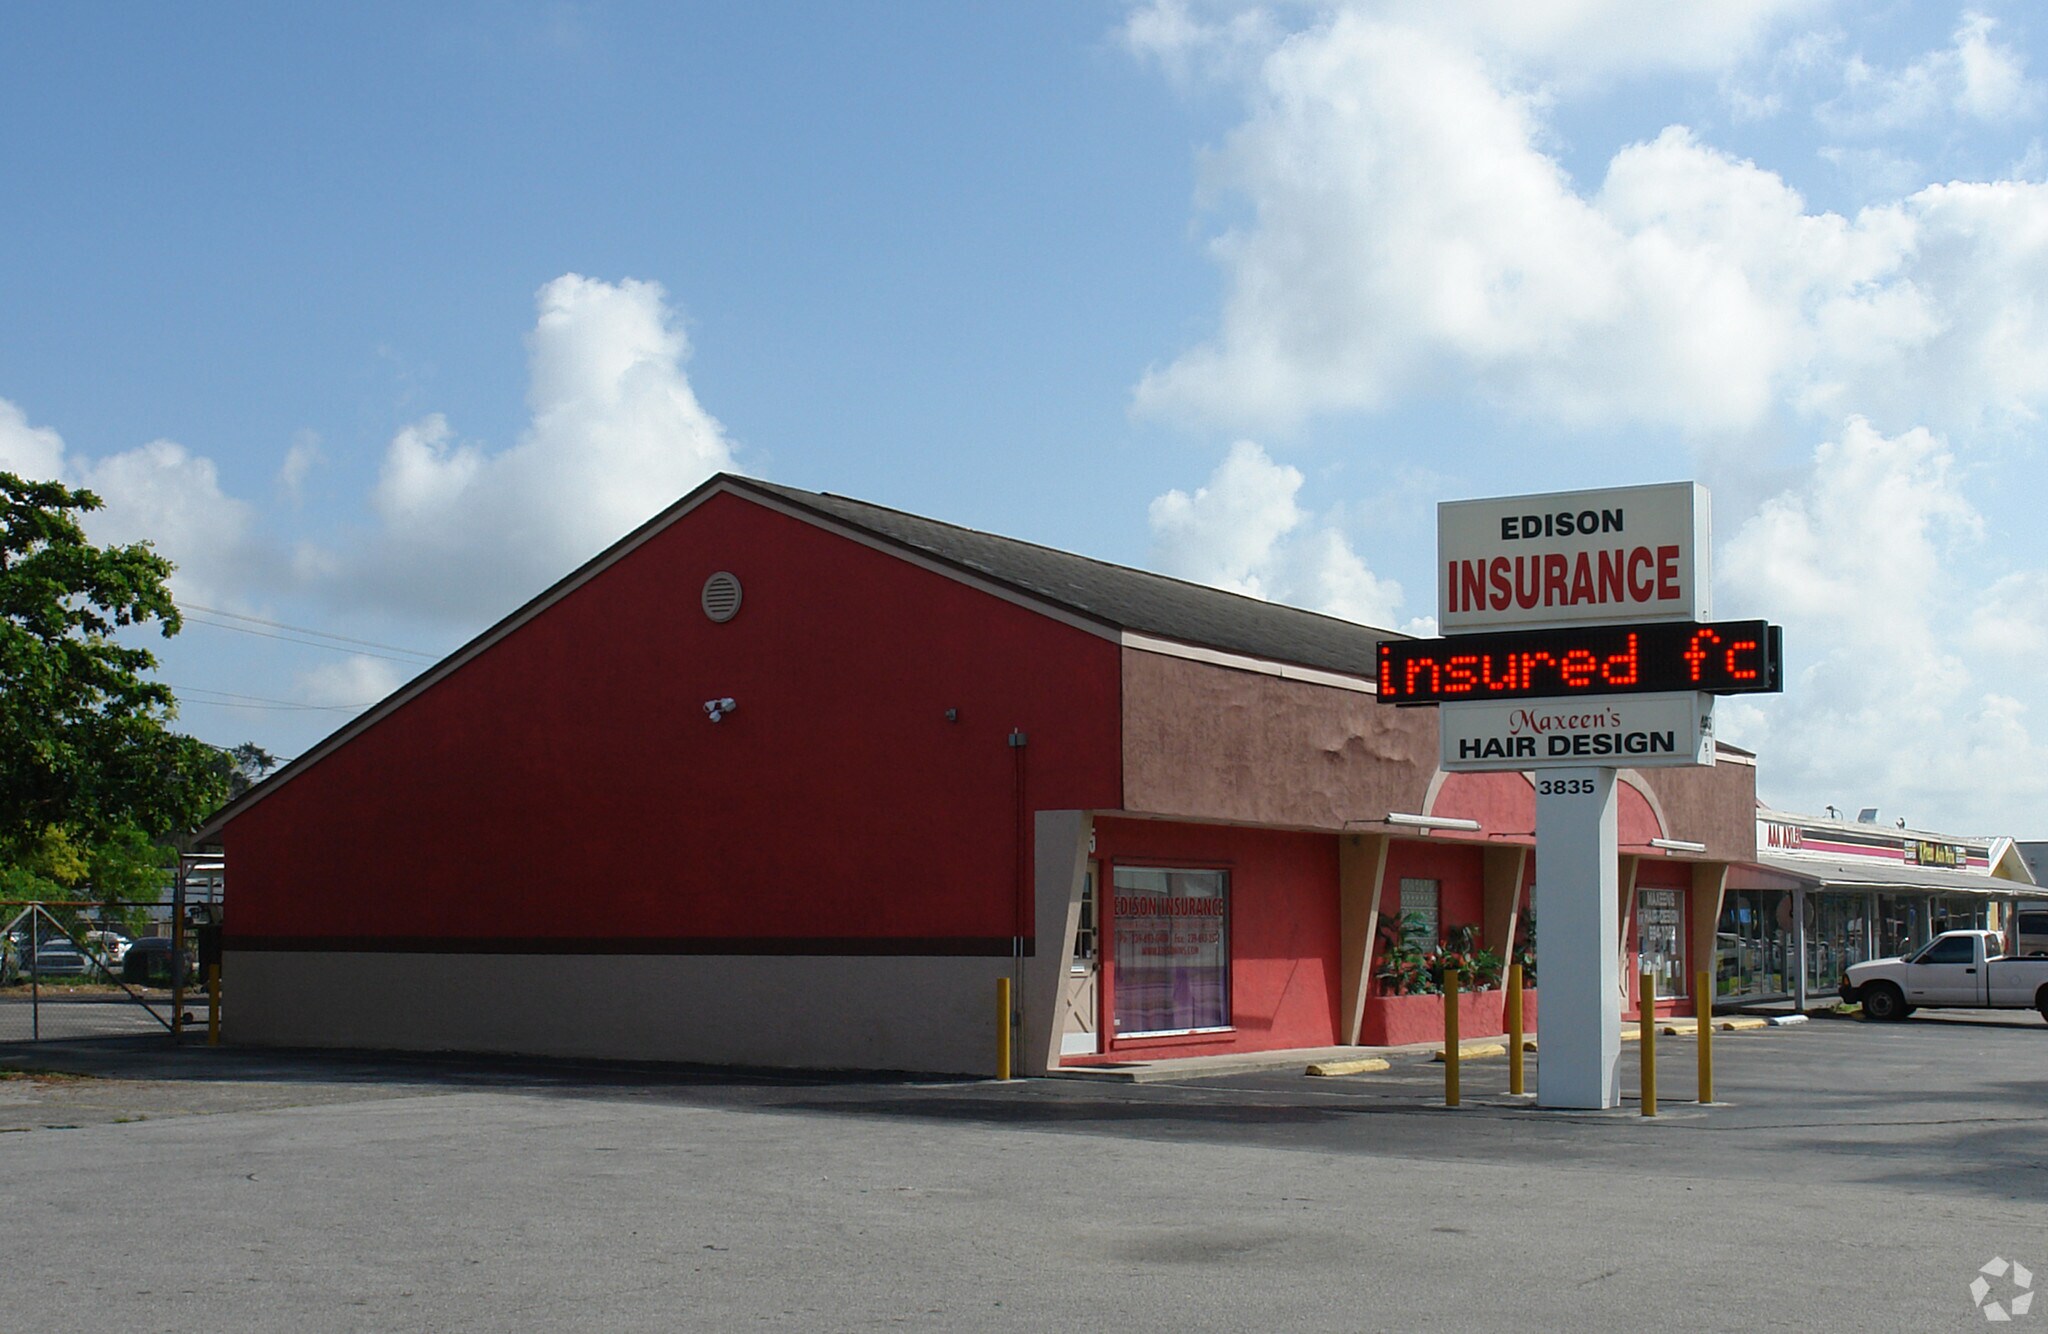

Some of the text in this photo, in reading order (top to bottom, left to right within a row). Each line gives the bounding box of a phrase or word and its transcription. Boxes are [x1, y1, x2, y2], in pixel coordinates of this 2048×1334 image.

[1501, 509, 1624, 540] EDISON
[1448, 545, 1681, 613] INSURANCE
[1381, 633, 1638, 696] insured
[1509, 707, 1621, 735] Maxeen's
[1459, 731, 1675, 759] HAIR DESIGN
[1539, 779, 1595, 795] 3835
[1768, 823, 1780, 847] AAA
[1114, 897, 1224, 917] EDISON INSURANCE
